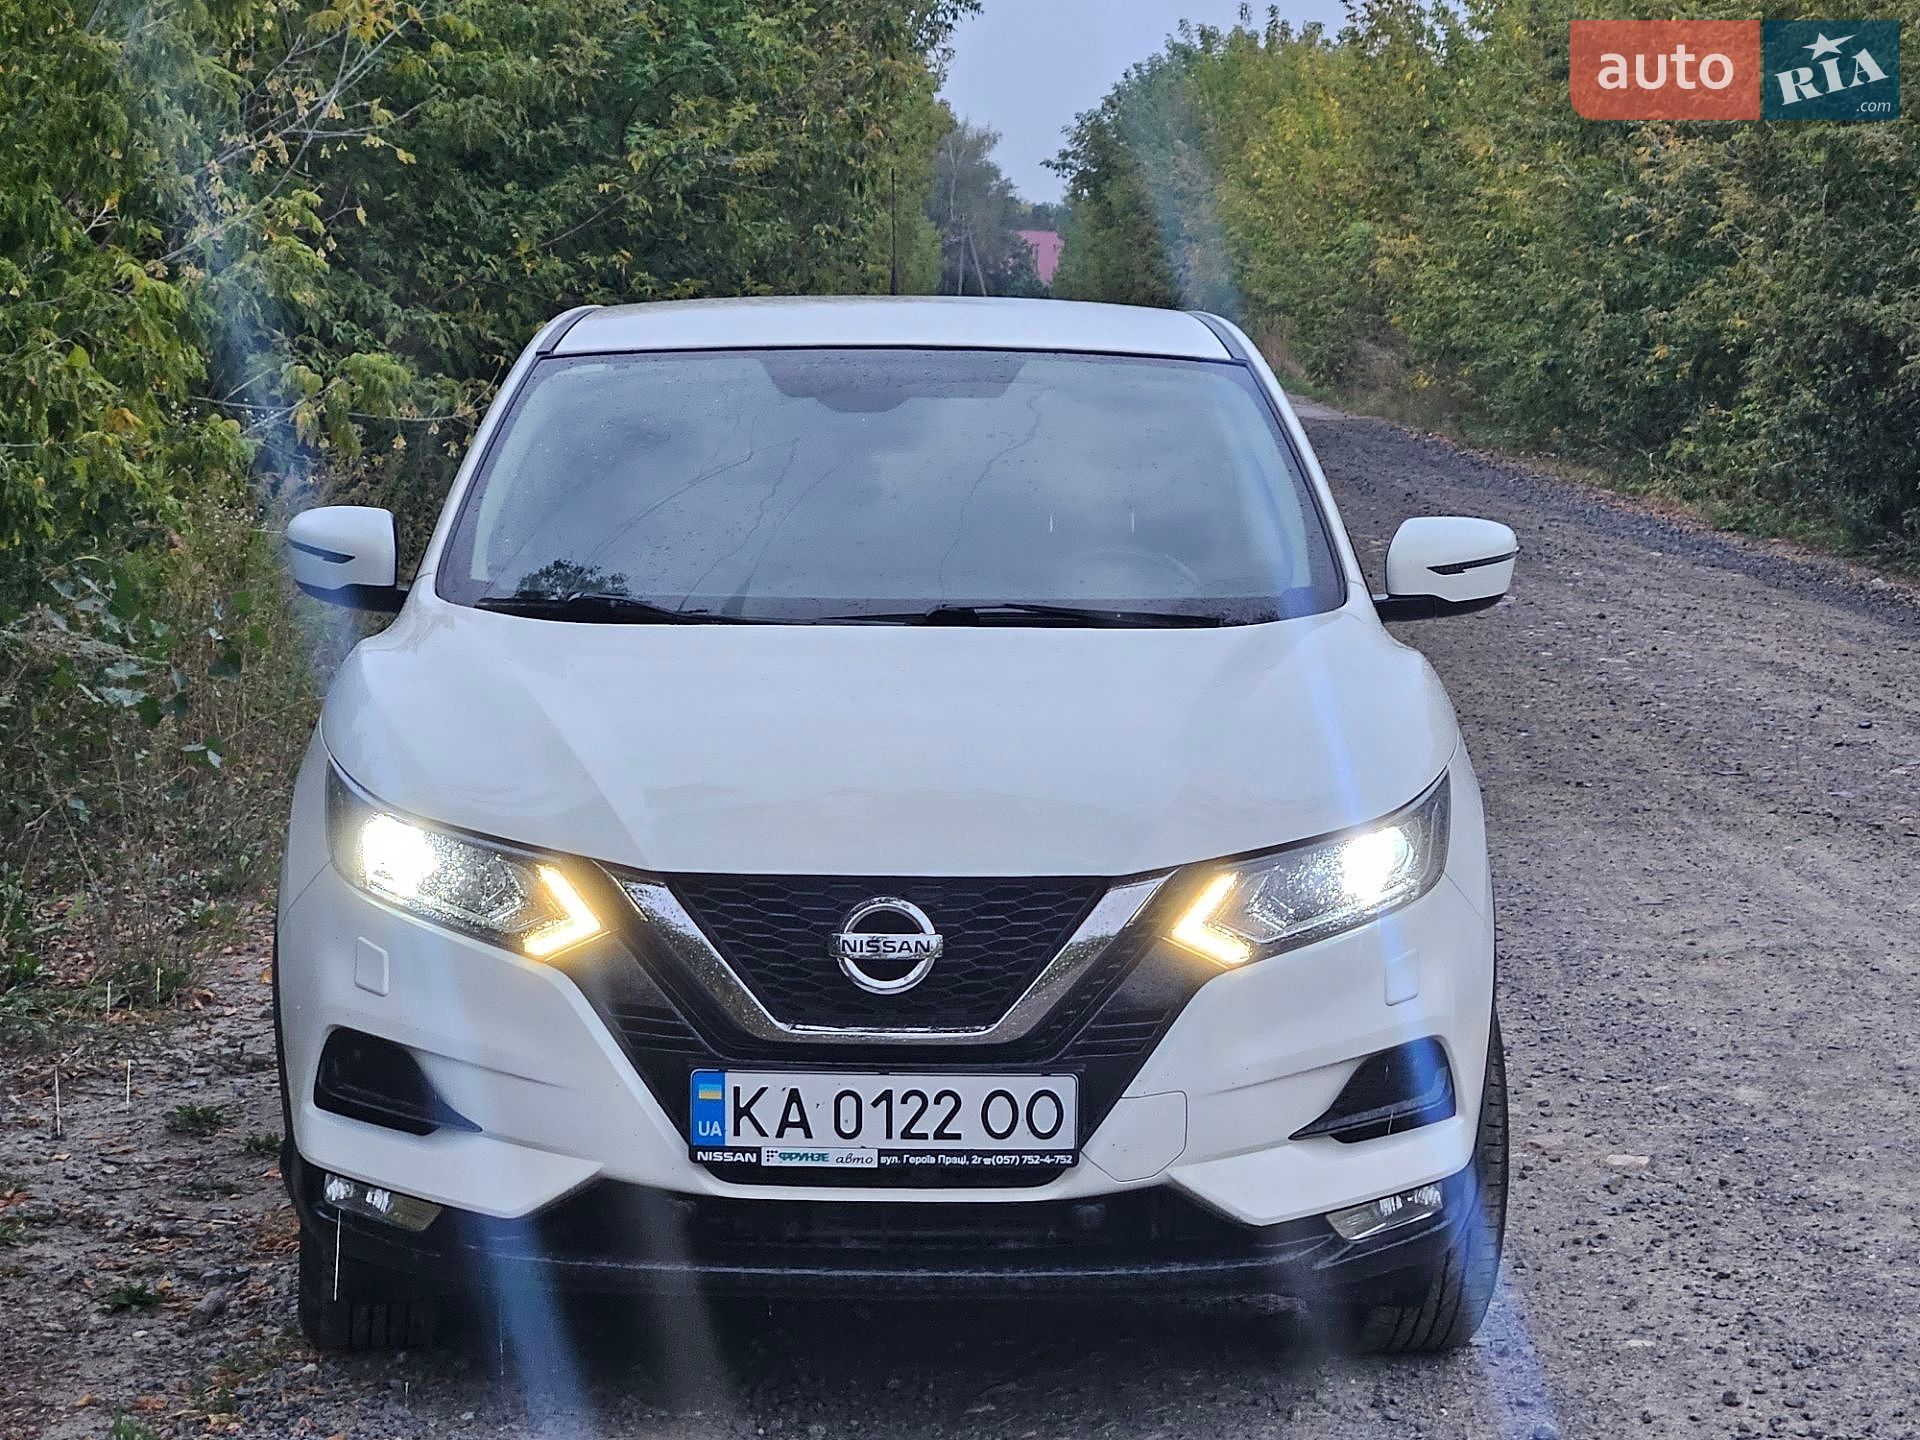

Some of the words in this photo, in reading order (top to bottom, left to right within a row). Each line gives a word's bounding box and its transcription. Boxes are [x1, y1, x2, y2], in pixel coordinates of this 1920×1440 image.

[841, 939, 930, 954] NISSAN
[732, 1086, 814, 1139] KA
[833, 1088, 963, 1141] 0122
[698, 1120, 723, 1138] UA
[697, 1151, 757, 1163] NISSAN
[835, 1152, 873, 1165] авто
[903, 1154, 936, 1165] Героїв
[1022, 1154, 1073, 1165] 752-4-752
